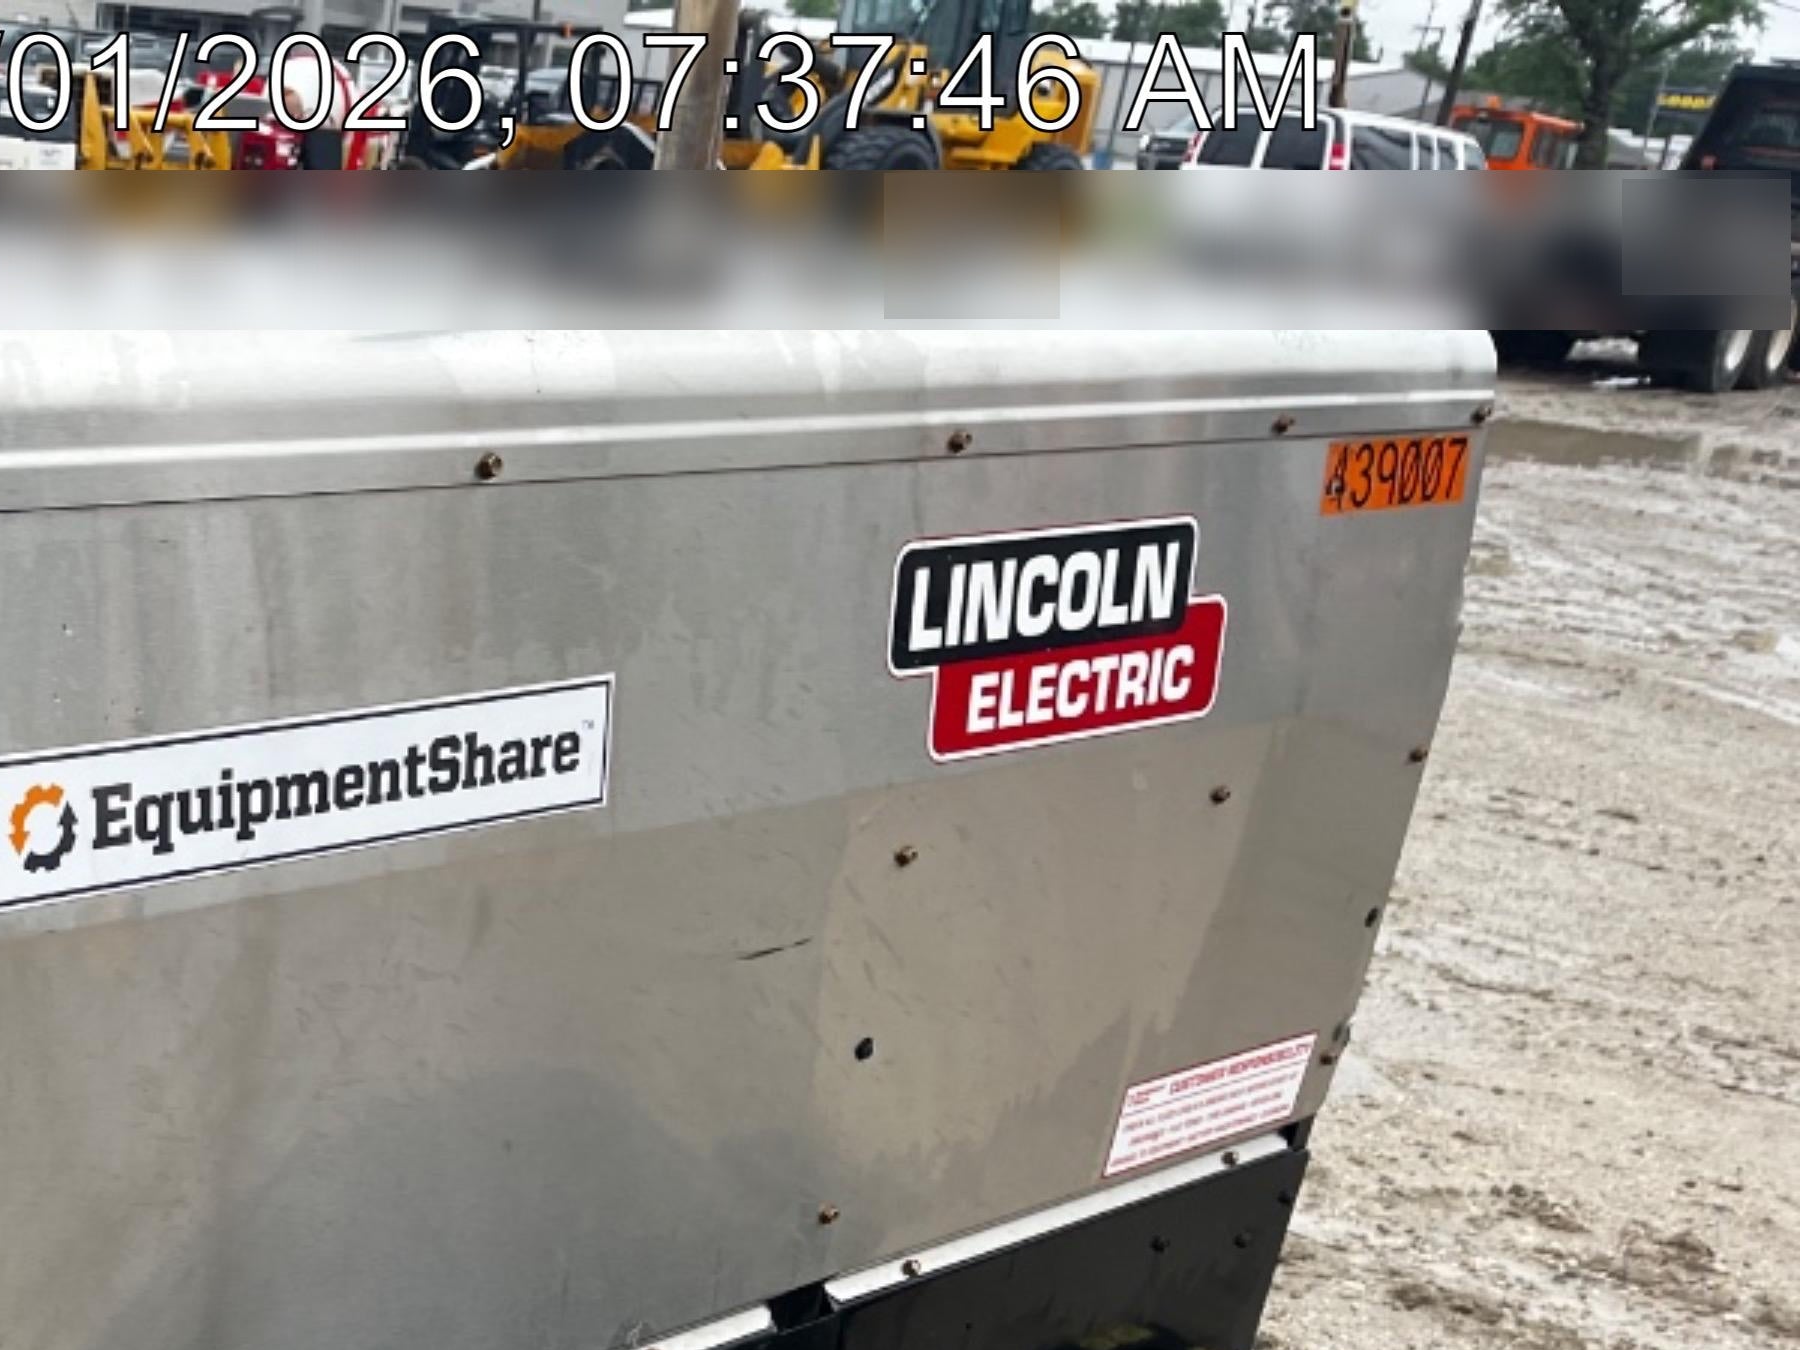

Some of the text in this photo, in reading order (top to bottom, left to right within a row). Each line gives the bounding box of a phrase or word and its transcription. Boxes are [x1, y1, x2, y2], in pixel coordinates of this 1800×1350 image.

[1324, 436, 1468, 511] 439007
[908, 541, 1180, 652] LINCOLN
[965, 644, 1195, 734] ELECTRIC
[91, 728, 581, 857] EquipmentShare
